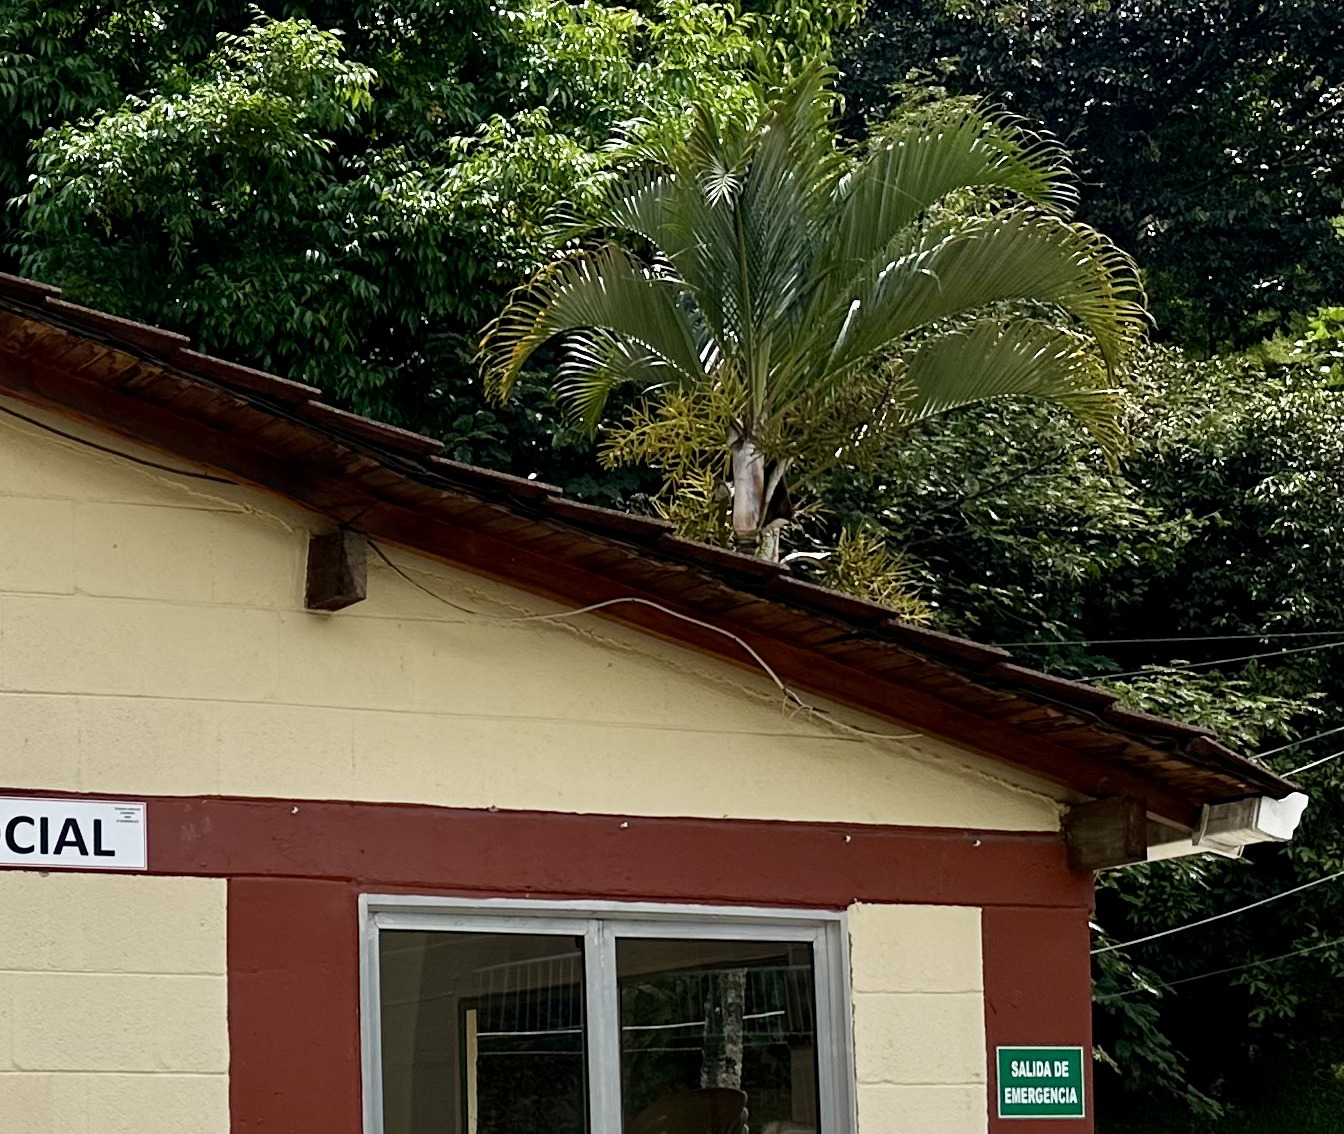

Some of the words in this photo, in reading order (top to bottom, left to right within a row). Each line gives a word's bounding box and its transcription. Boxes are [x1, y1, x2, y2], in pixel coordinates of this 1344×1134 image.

[1011, 1061, 1052, 1077] SALIDA
[1054, 1061, 1069, 1077] DE
[1005, 1087, 1077, 1104] EMERGENCIA
